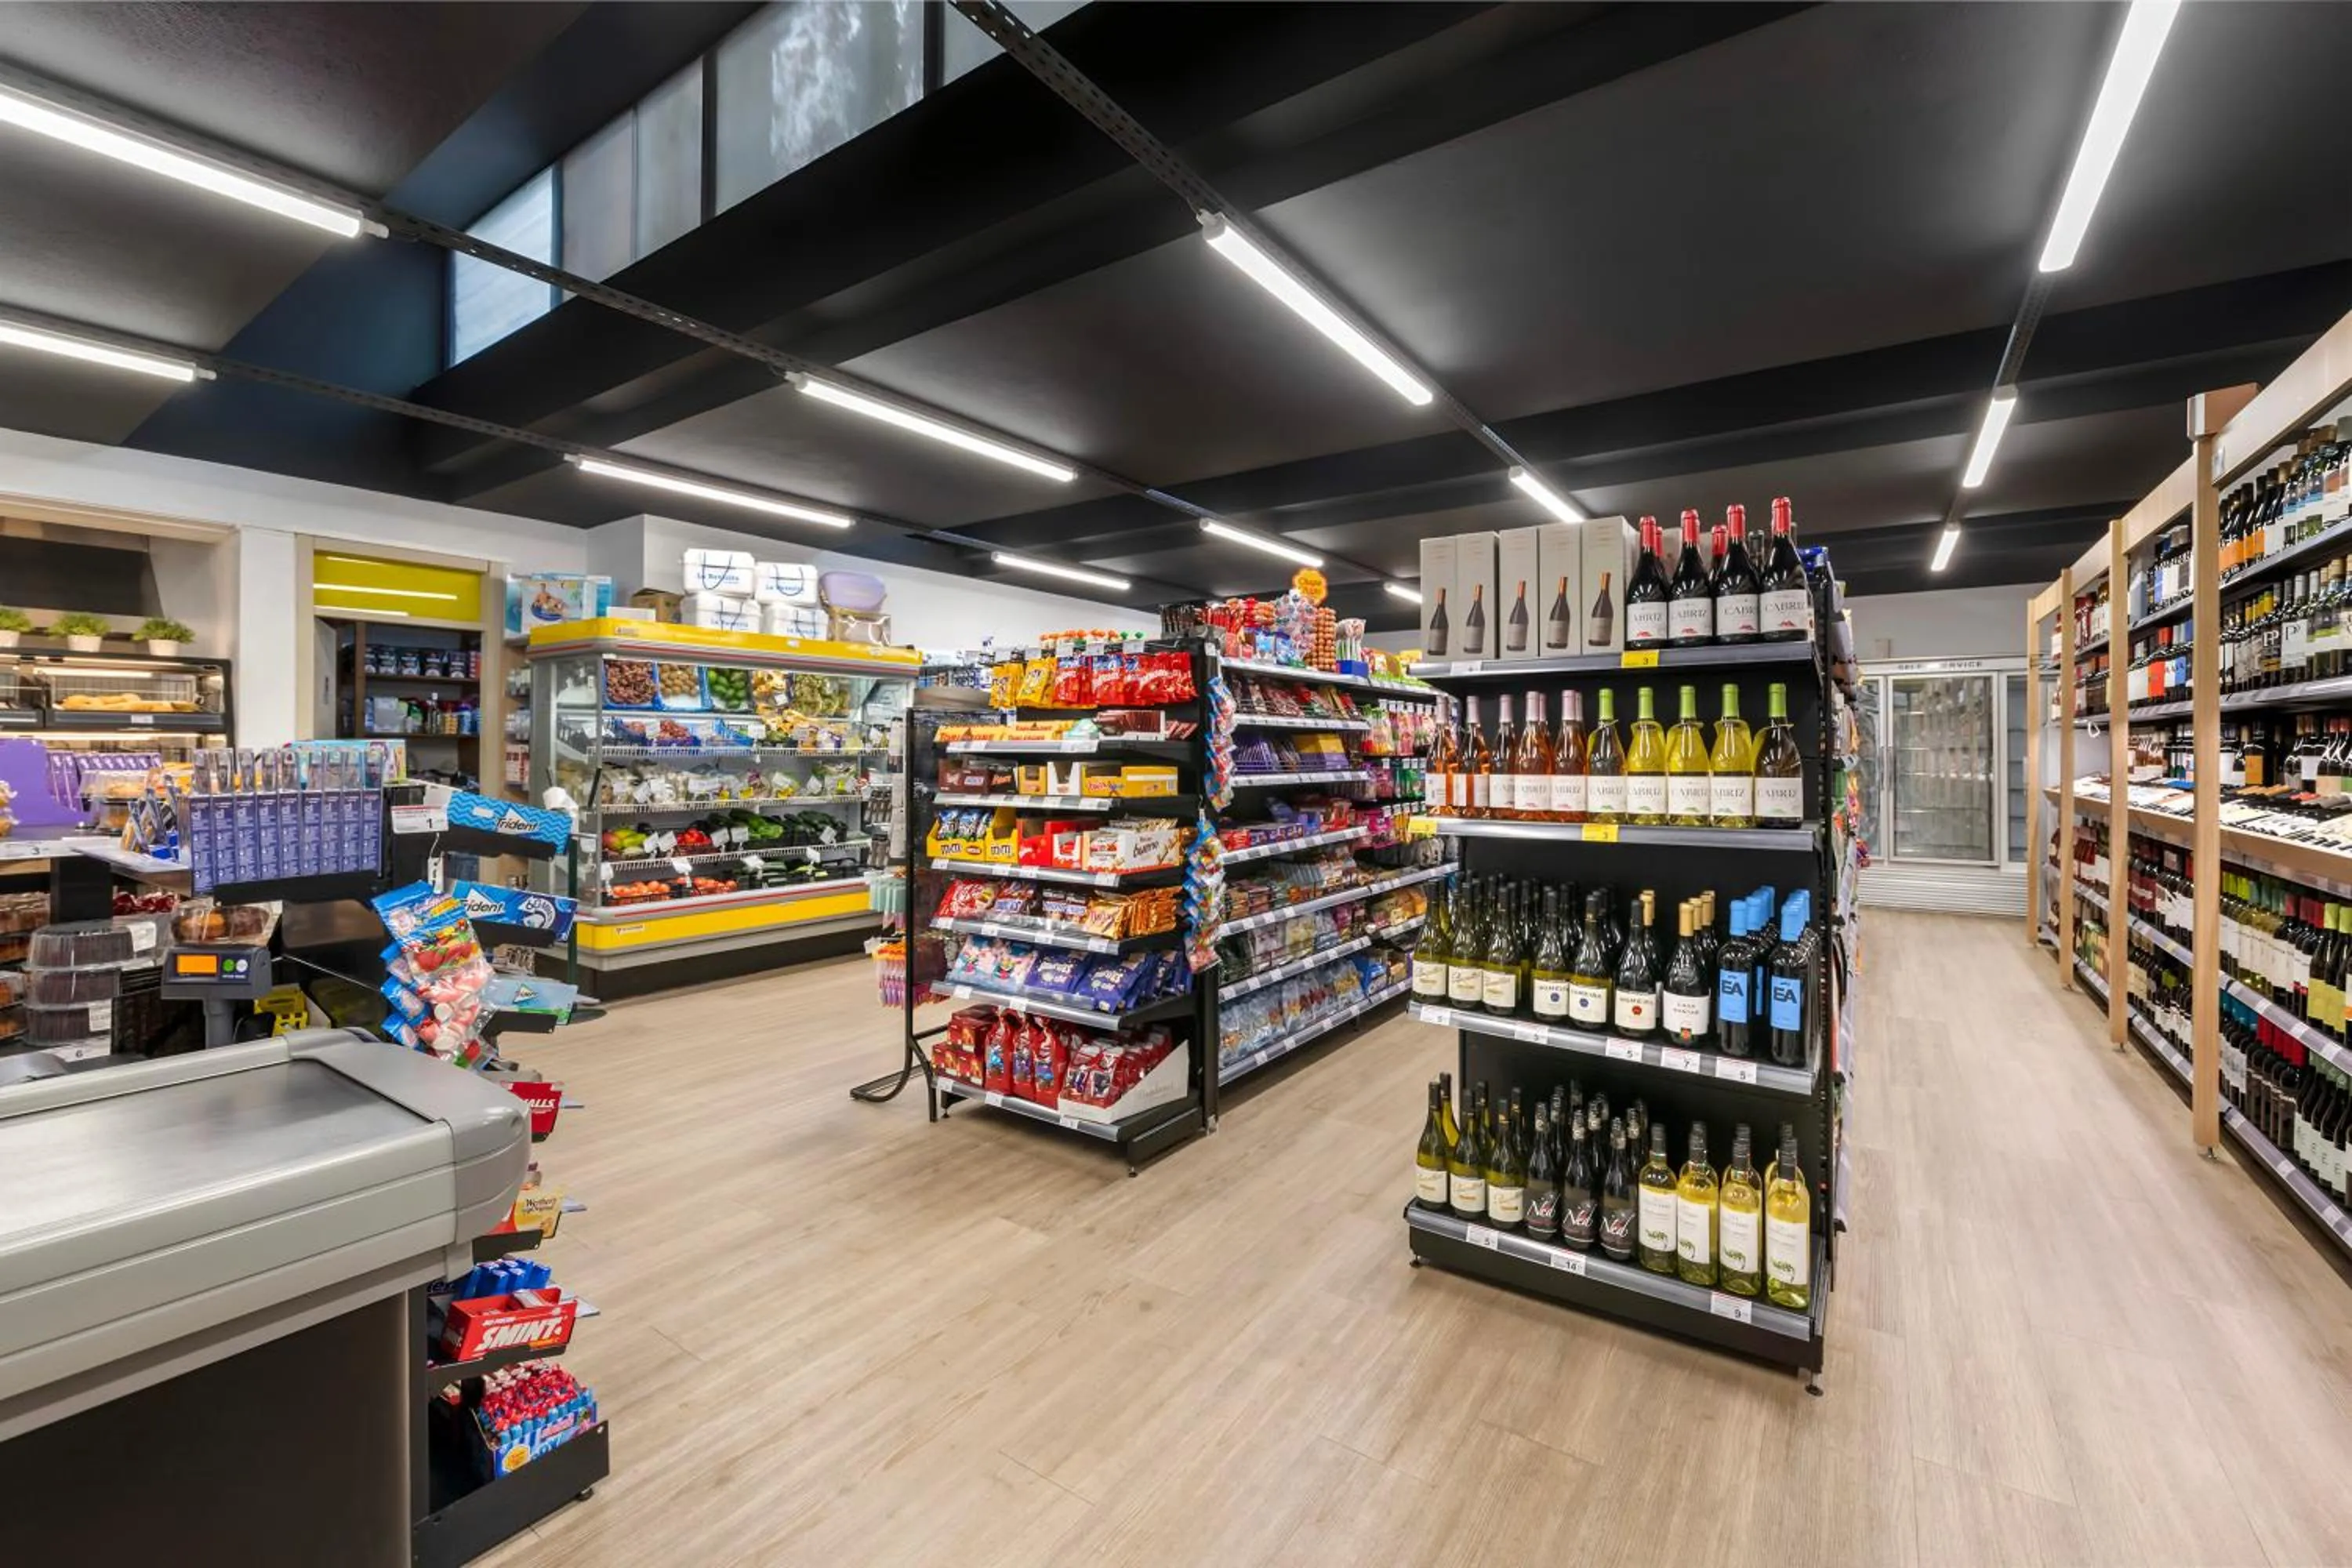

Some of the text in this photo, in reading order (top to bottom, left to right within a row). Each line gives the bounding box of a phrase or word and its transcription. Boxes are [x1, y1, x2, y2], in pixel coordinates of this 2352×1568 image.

[1723, 604, 1755, 616] CABR
[426, 818, 433, 829] 1
[496, 818, 537, 831] Trident
[464, 902, 504, 913] rident
[1720, 980, 1744, 997] EA
[1773, 986, 1798, 1004] EA
[526, 1099, 556, 1108] ALLS
[1528, 1192, 1561, 1218] Ned
[1563, 1203, 1598, 1228] Ned
[1599, 1210, 1636, 1237] Ned
[475, 1317, 562, 1351] SMINT
